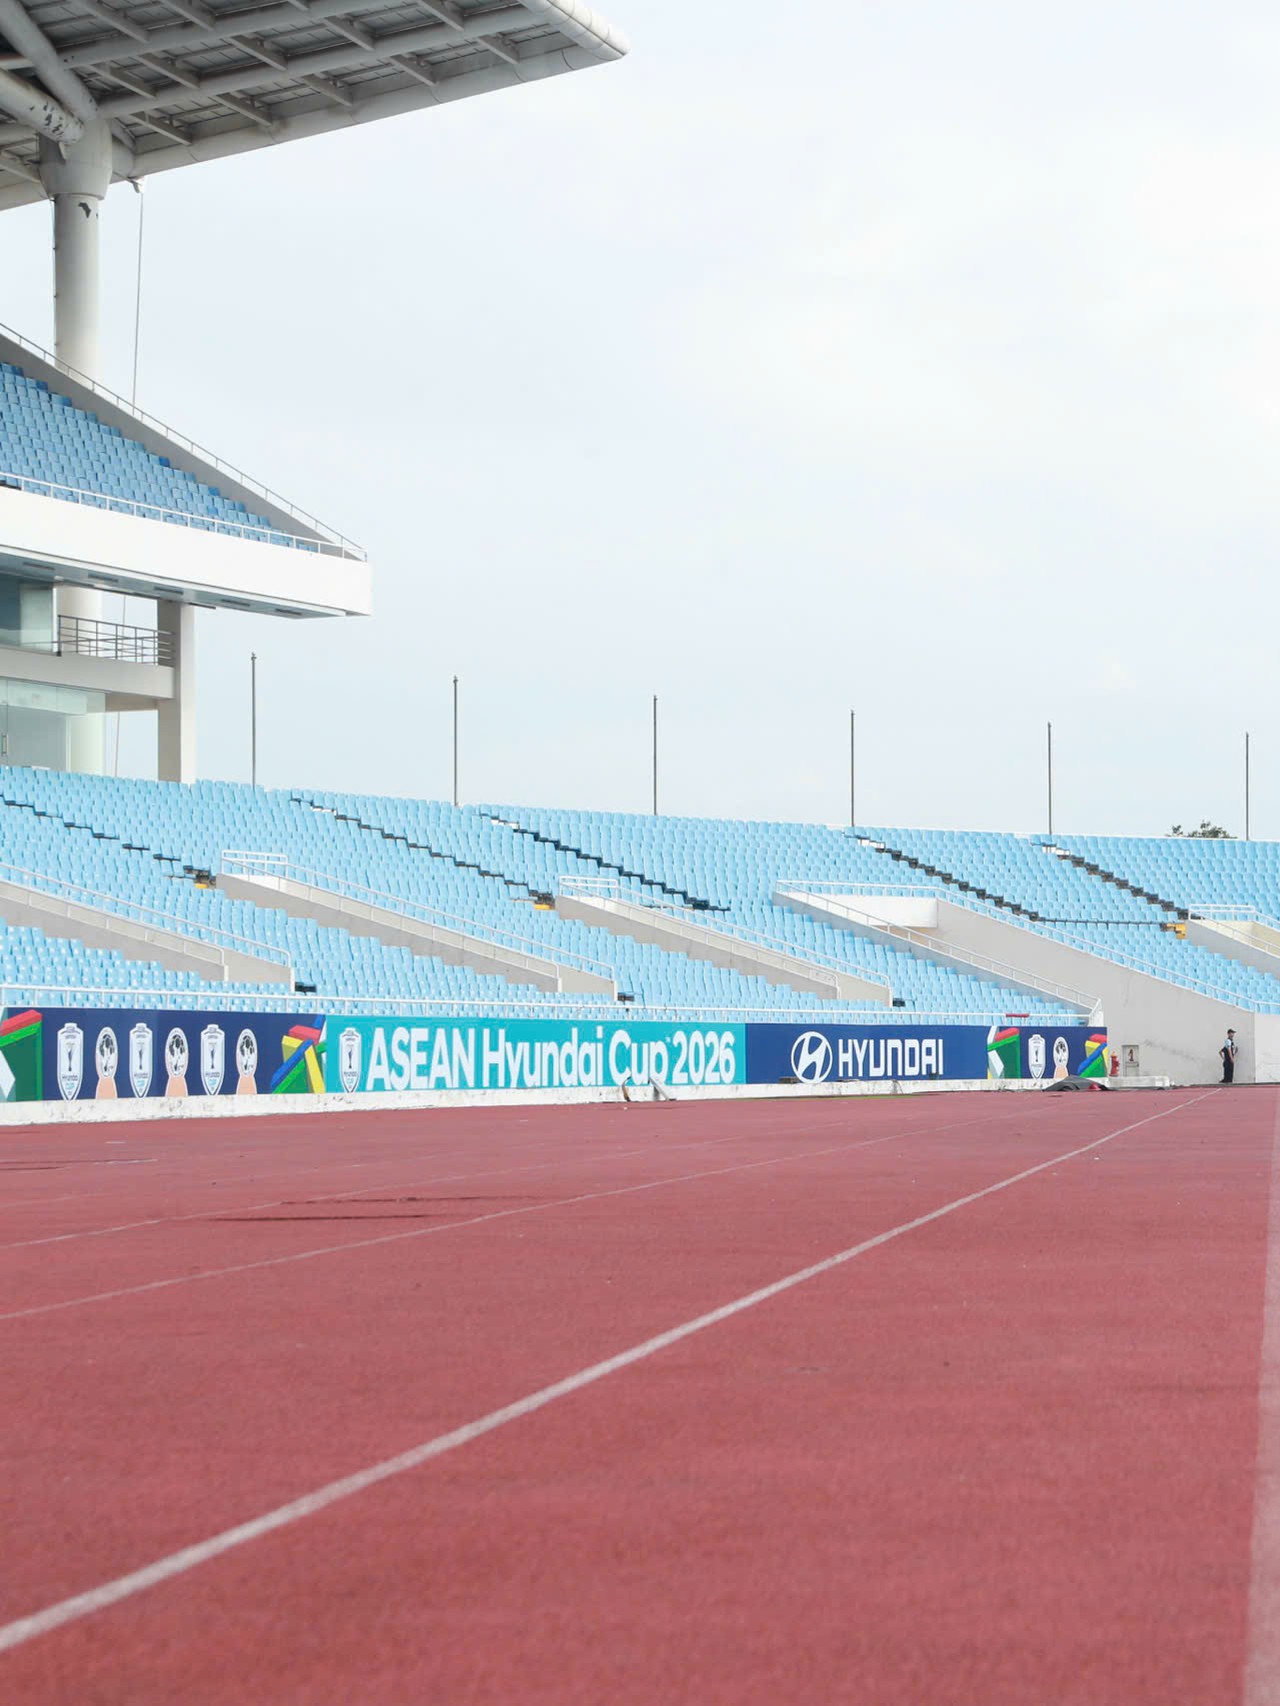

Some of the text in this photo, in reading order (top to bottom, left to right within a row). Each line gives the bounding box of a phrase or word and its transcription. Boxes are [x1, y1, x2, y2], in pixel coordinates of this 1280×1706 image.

[366, 1027, 476, 1090] ASEAN
[483, 1026, 603, 1088] Hyundai
[608, 1029, 669, 1088] Cup
[672, 1030, 736, 1084] 2026
[838, 1039, 944, 1077] HYUNDAI
